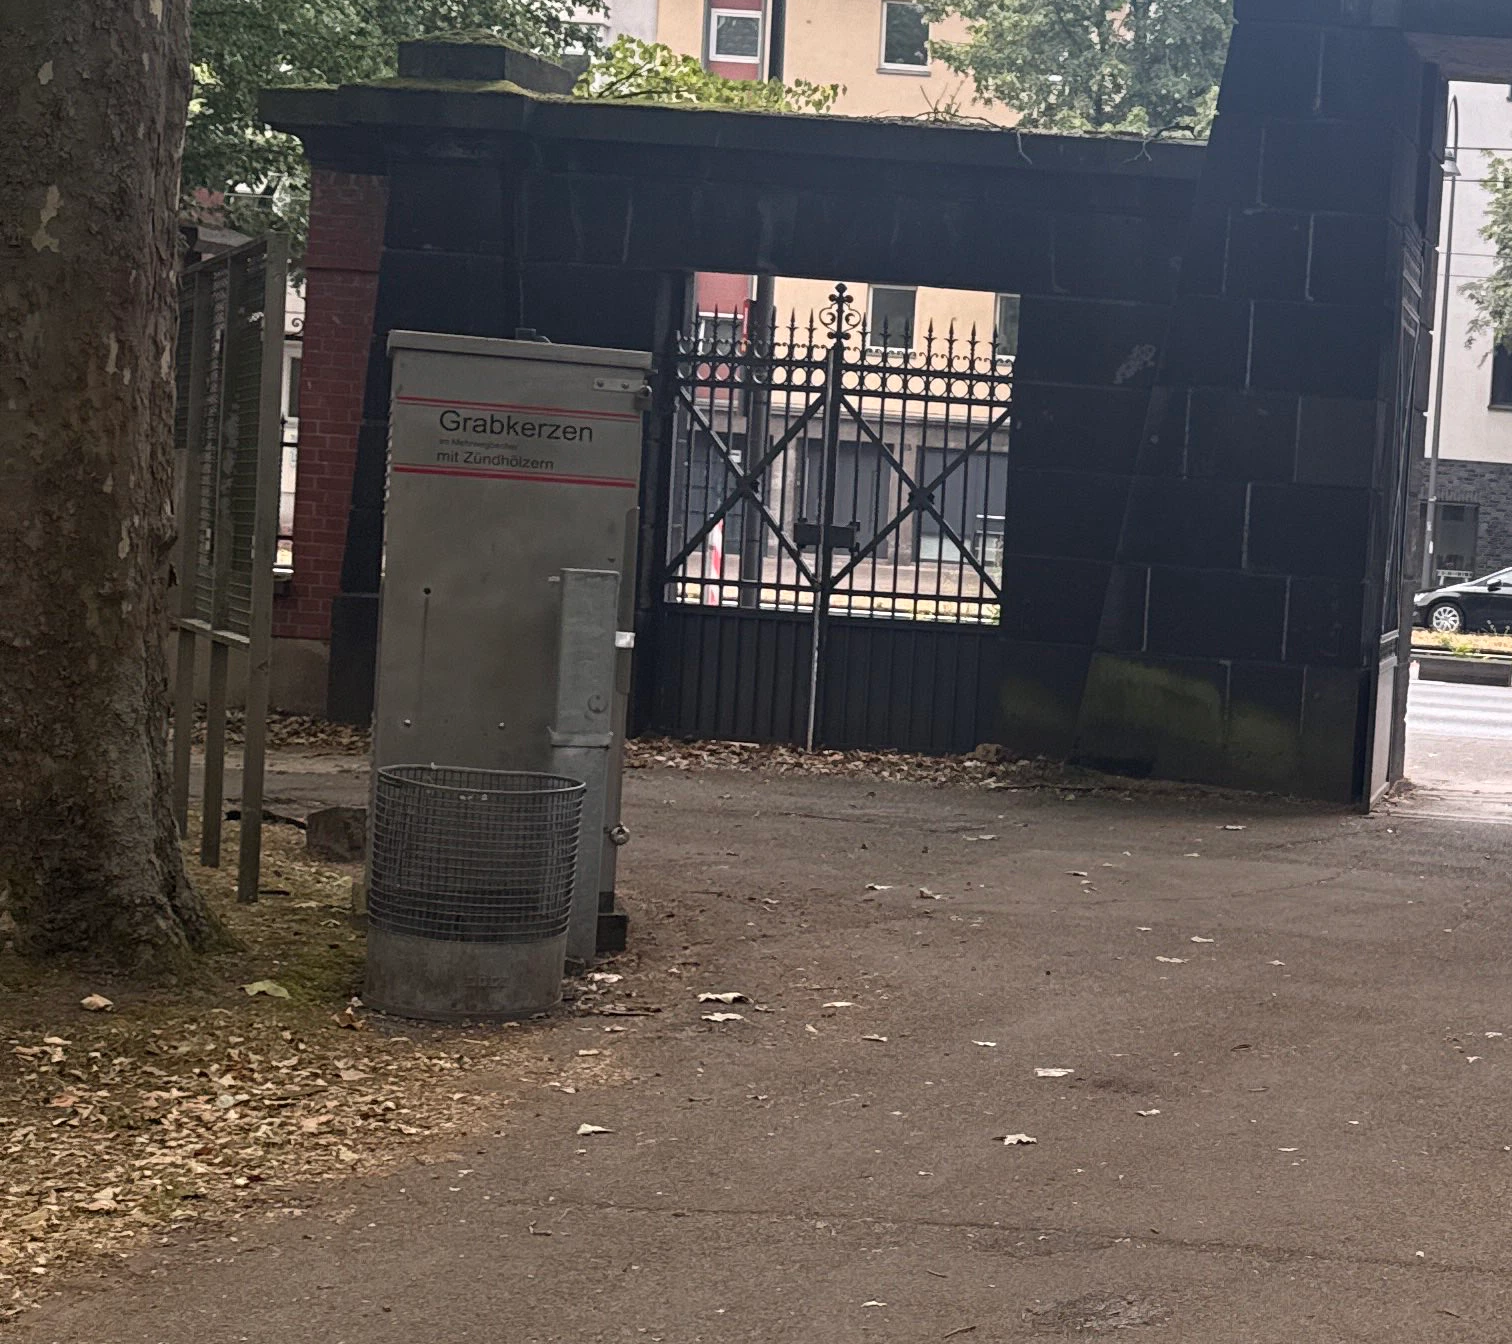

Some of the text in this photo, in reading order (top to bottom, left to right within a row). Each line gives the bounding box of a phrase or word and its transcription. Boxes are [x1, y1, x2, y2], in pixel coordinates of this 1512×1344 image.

[439, 410, 593, 442] Grabkerzen
[437, 451, 555, 470] mit Zündhölzern
